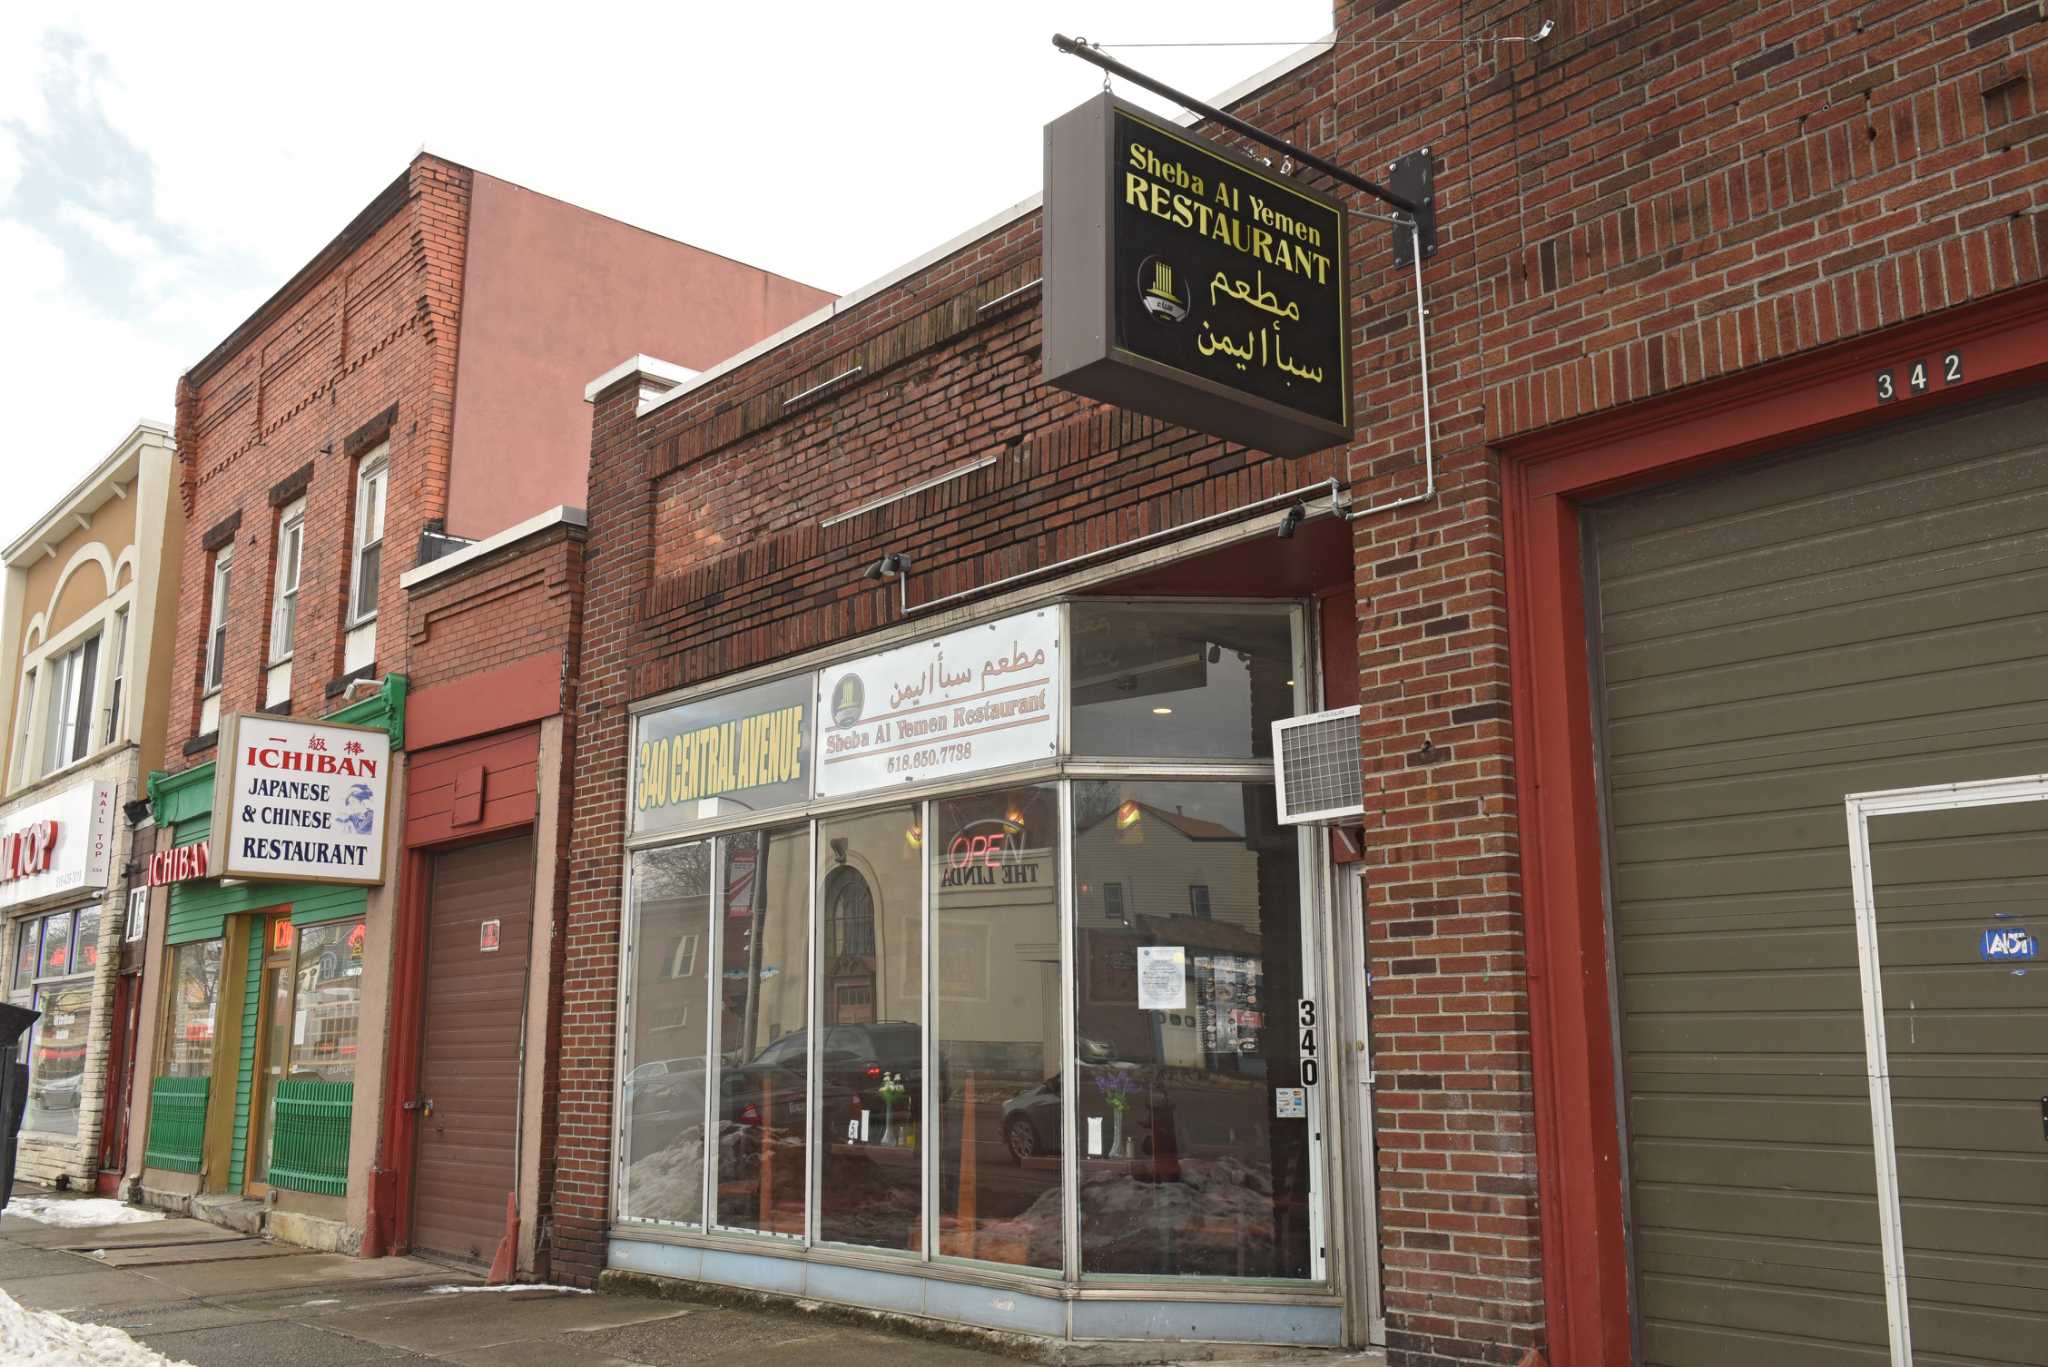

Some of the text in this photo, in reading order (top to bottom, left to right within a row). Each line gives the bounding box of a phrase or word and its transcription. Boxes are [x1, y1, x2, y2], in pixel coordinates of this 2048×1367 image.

[1130, 143, 1320, 248] Sheba Al Yemen
[1126, 171, 1330, 285] RESTAURANT
[1210, 269, 1300, 321] مطعم
[1878, 354, 1961, 399] 342
[981, 640, 1045, 691] مطعم
[826, 688, 1046, 754] Sheba Al Yemen Restaurant
[247, 747, 377, 778] ICHIBAN
[638, 704, 804, 811] 340 CENTRAL AVENUE
[248, 778, 330, 802] JAPANESE
[242, 805, 331, 830] & CHINESE
[242, 837, 368, 866] RESTAURANT
[950, 832, 1025, 869] OPEN
[1300, 1000, 1318, 1086] 340
